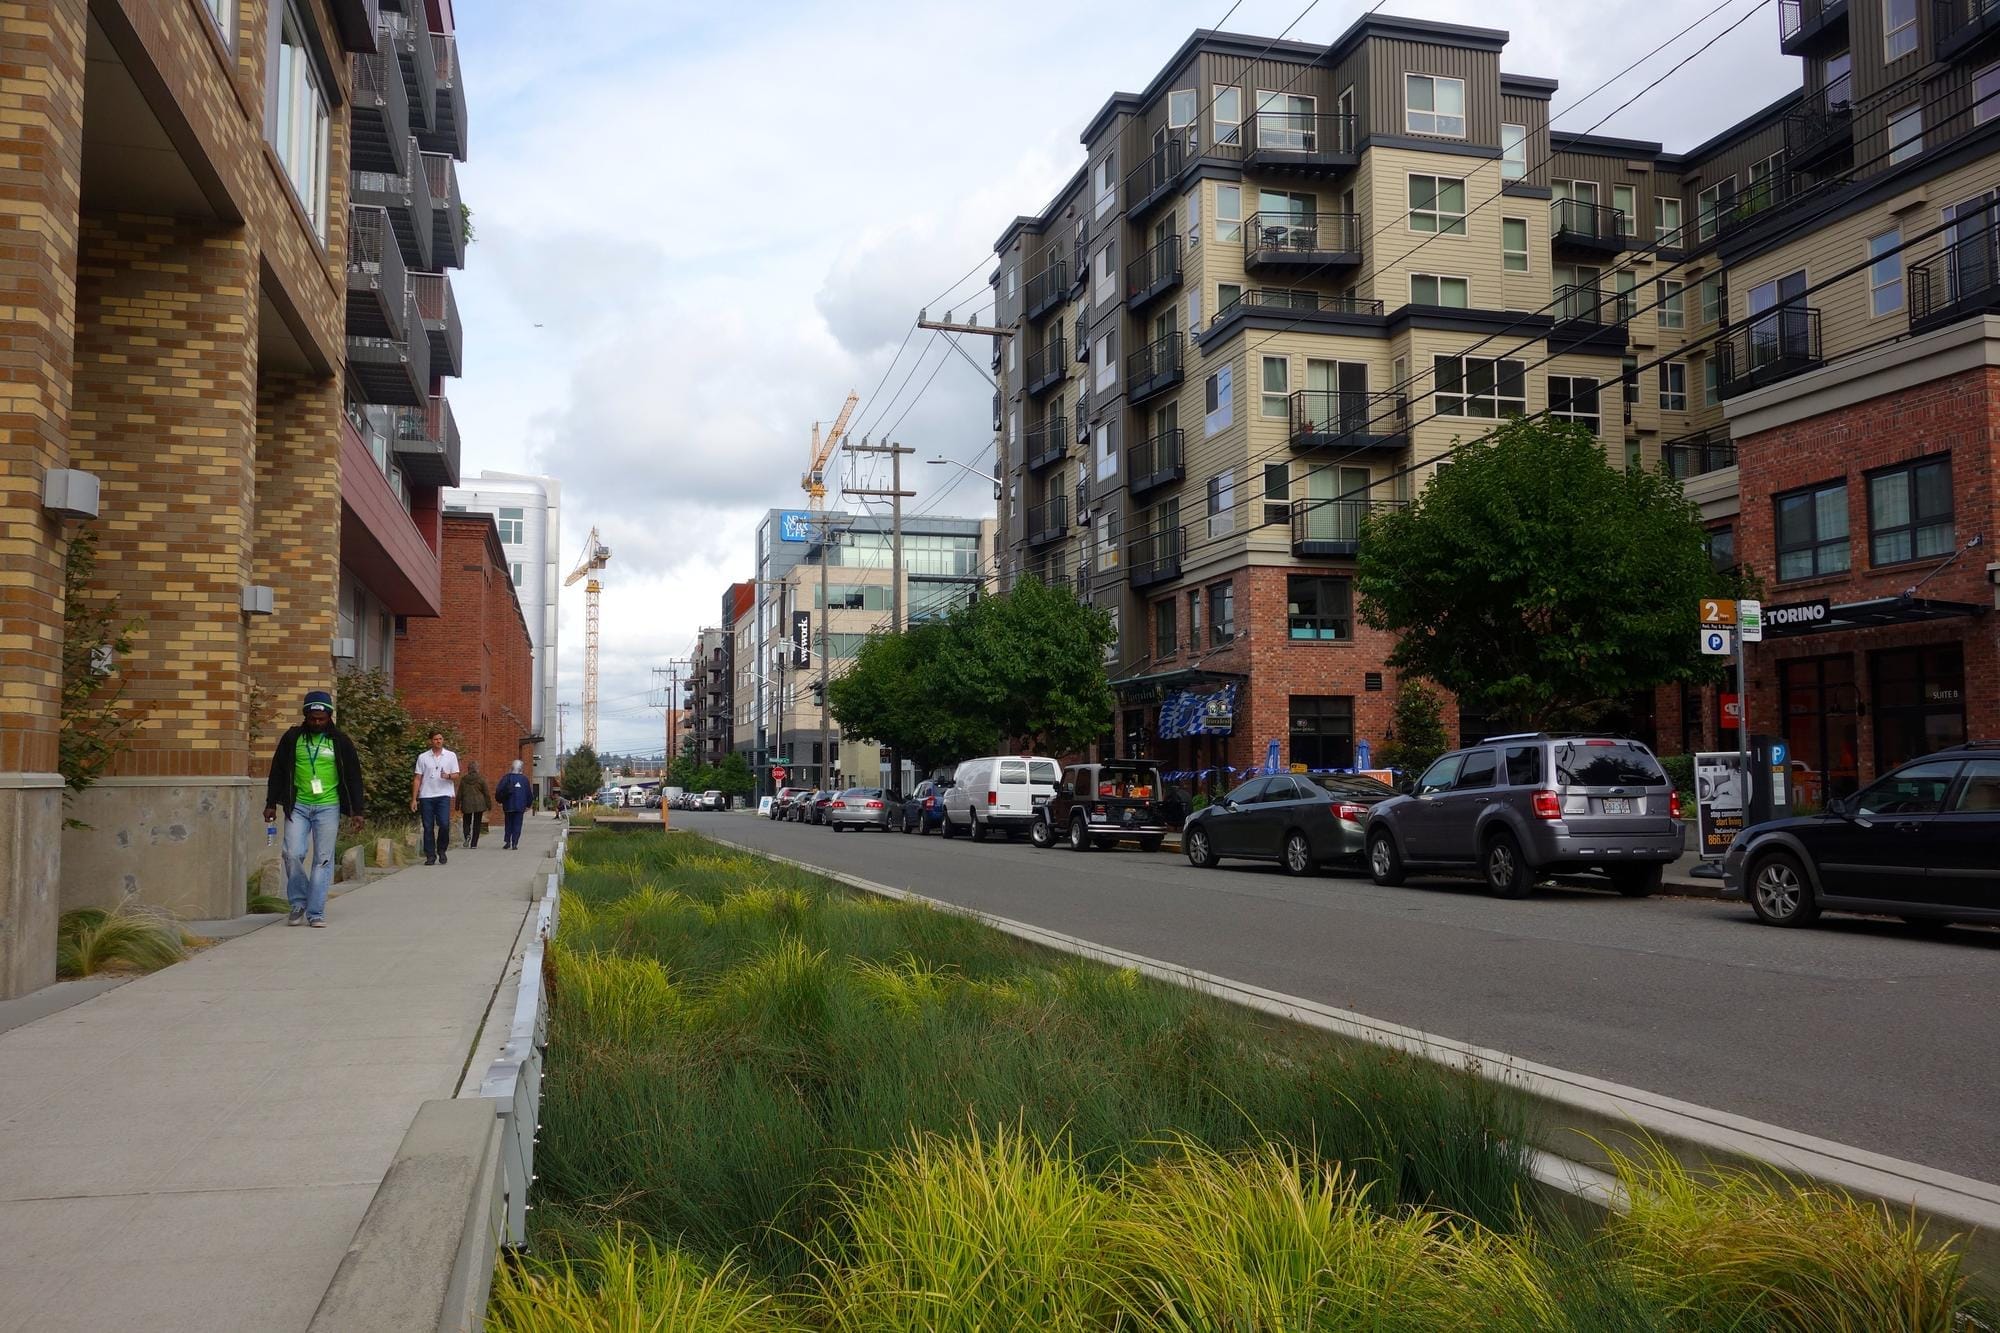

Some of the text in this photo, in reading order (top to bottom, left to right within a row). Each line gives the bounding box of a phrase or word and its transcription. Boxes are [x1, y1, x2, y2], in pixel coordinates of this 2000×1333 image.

[783, 521, 808, 531] YORK
[787, 529, 806, 537] LIFE
[1705, 602, 1719, 621] 2
[1767, 604, 1825, 625] TORINO
[1932, 690, 1953, 699] SUITE
[1773, 746, 1782, 761] P
